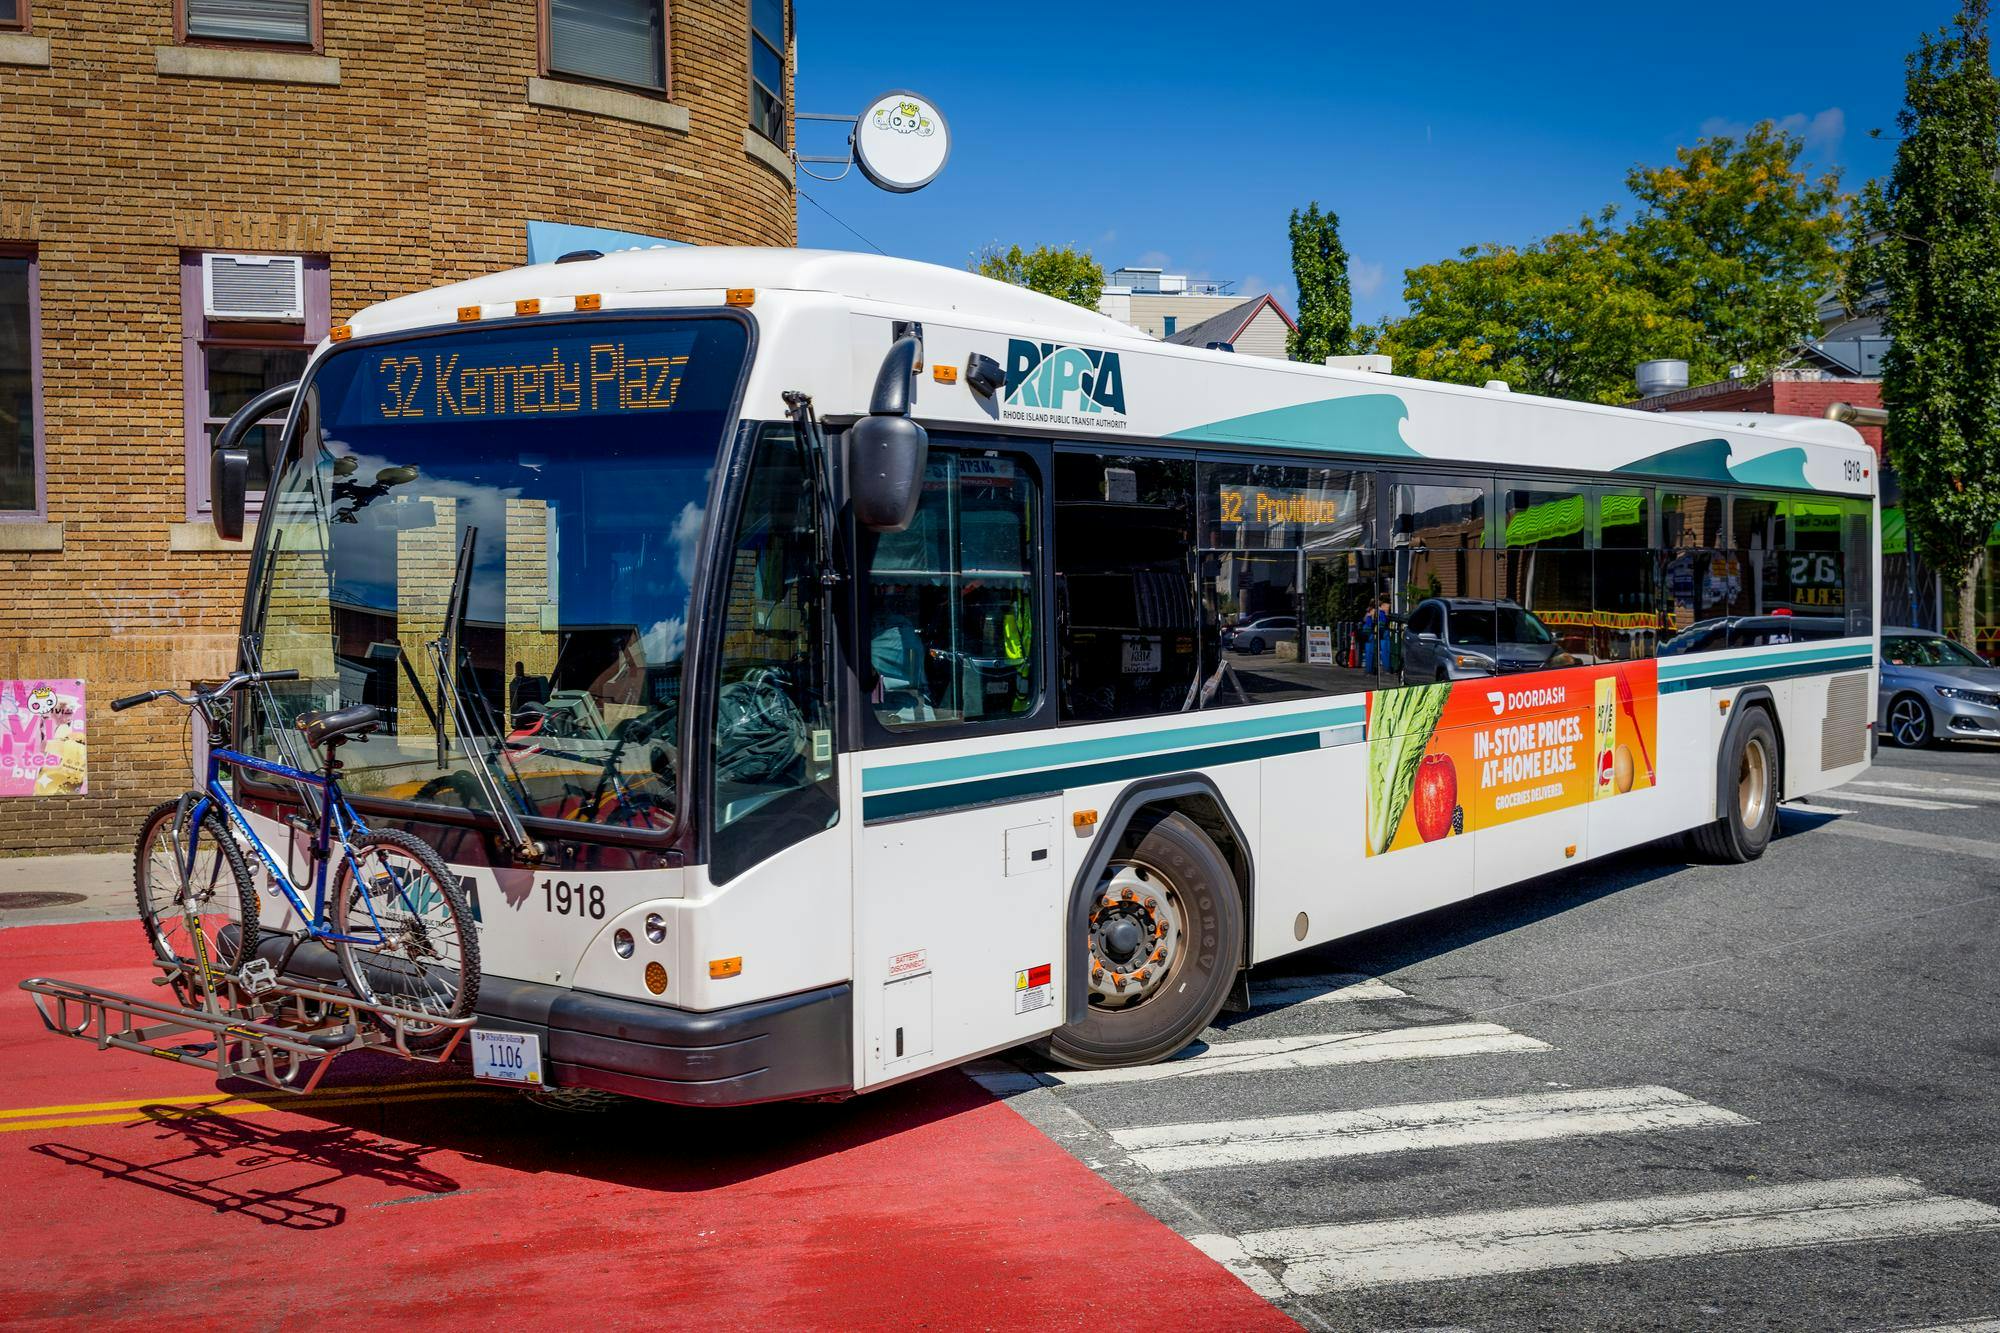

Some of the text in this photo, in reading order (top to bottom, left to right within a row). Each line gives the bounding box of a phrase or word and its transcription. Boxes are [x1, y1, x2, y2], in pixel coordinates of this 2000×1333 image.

[380, 356, 424, 417] 32
[436, 347, 581, 416] Kennedy
[1003, 411, 1127, 429] RHODE ISLAND PUBLIC TRANSIT AUTHORITY
[1843, 459, 1860, 482] 1918
[1220, 492, 1336, 523] 32 Providence
[1508, 686, 1566, 711] DOORDASH
[1474, 716, 1584, 760] IN-STORE PRICES.
[1481, 745, 1577, 789] AT-HOME EASE.
[1495, 787, 1531, 811] GROCERIES
[541, 878, 606, 921] 1918
[890, 959, 925, 974] DISCONNECT
[895, 952, 920, 965] BATTERY
[489, 1044, 523, 1069] 1106
